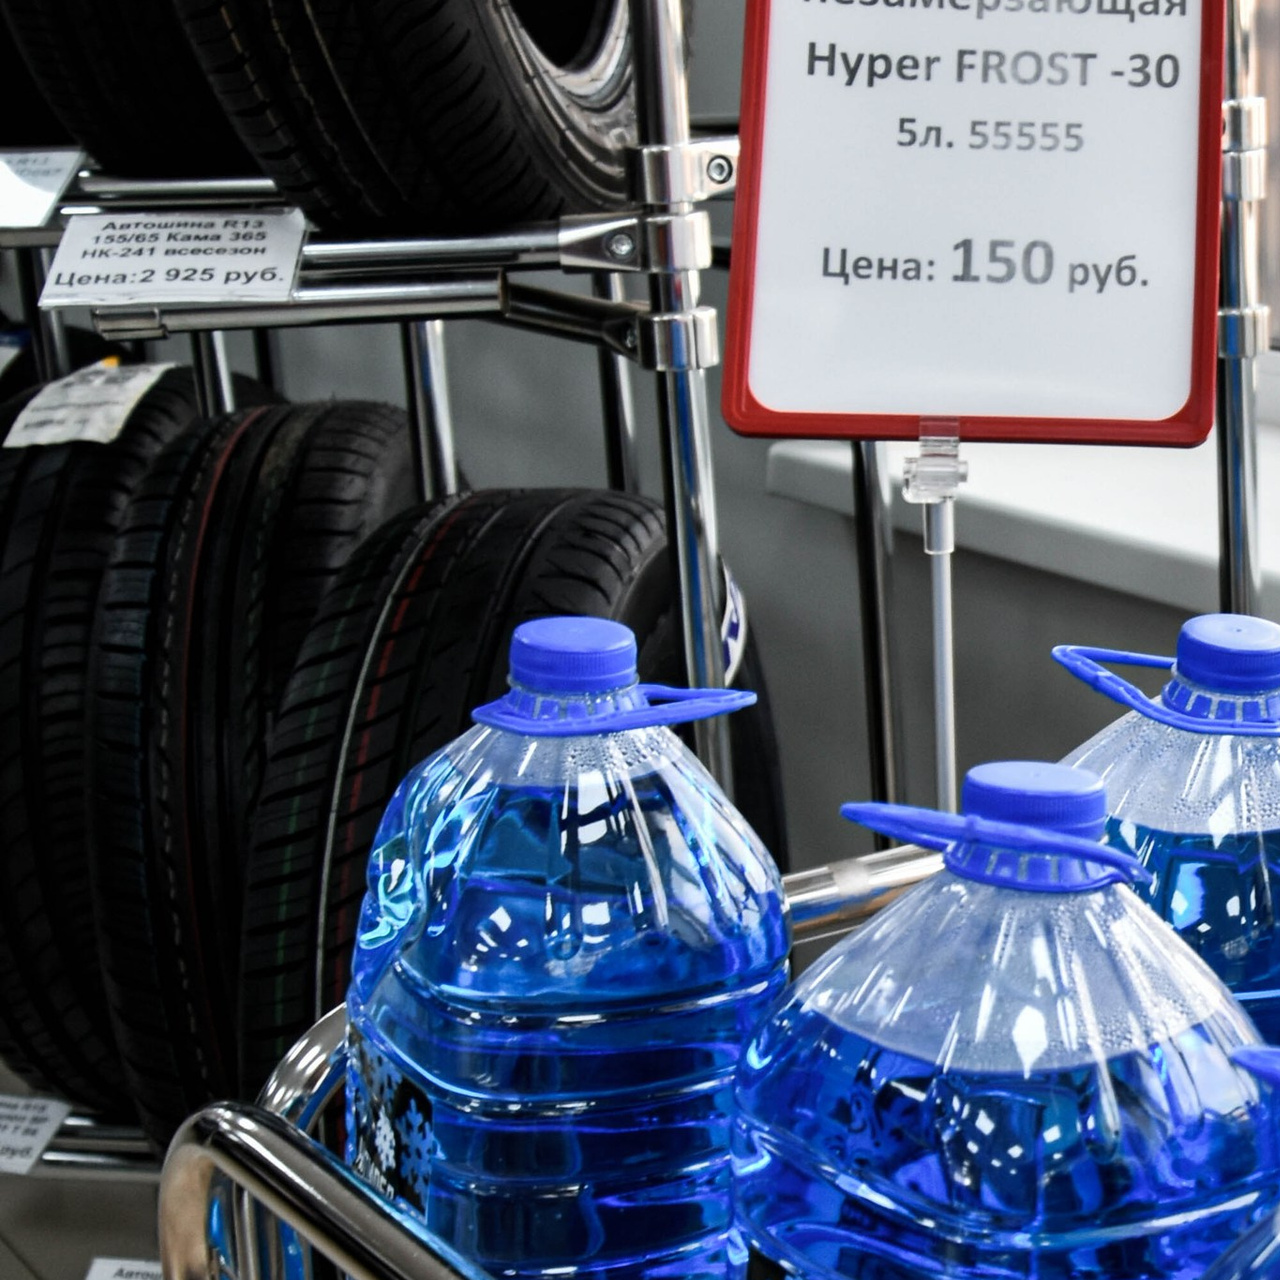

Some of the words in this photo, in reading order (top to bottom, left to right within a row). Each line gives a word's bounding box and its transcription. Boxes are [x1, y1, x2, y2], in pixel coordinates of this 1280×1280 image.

[806, 42, 941, 89] Hyper
[956, 49, 1098, 87] FROST
[1110, 53, 1181, 88] -30
[896, 118, 955, 150] 5л.
[968, 120, 1085, 152] 55555
[102, 219, 215, 231] Автошина
[223, 219, 265, 229] R13
[93, 232, 160, 244] 155/65
[166, 232, 222, 242] Кама
[229, 231, 267, 241] 365
[164, 247, 267, 256] всесезон
[821, 246, 936, 286] Цена:
[951, 238, 1055, 285] 150
[1067, 256, 1149, 293] руб.
[165, 268, 215, 282] 925
[223, 267, 285, 285] руб.
